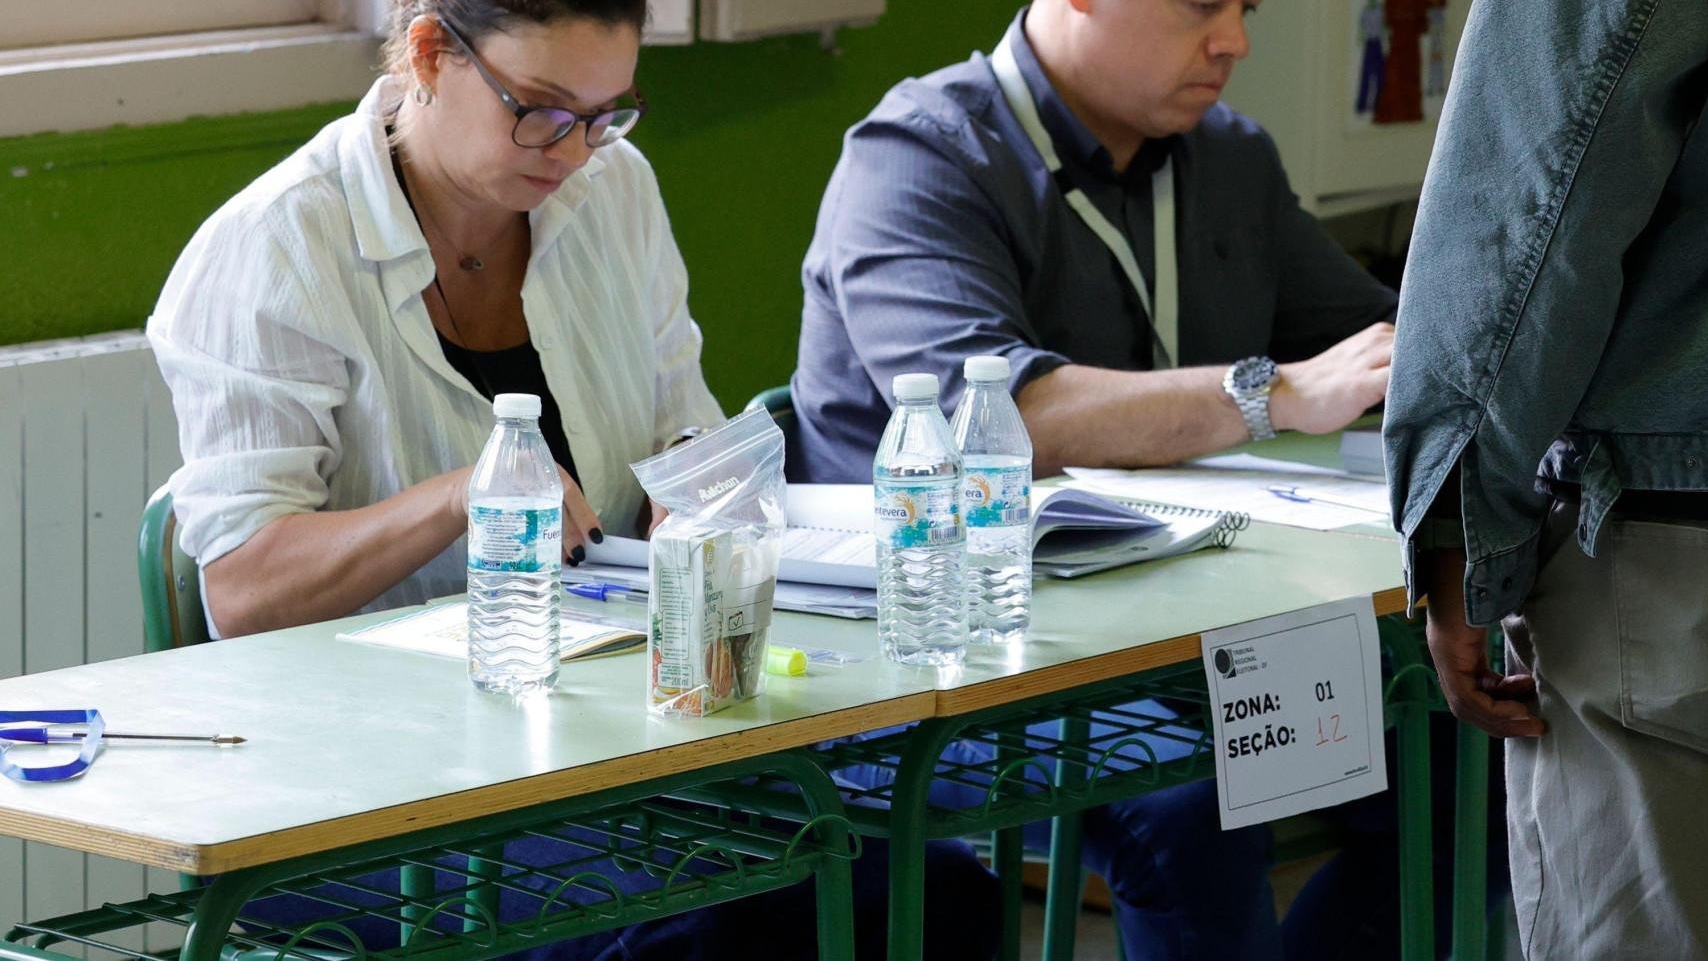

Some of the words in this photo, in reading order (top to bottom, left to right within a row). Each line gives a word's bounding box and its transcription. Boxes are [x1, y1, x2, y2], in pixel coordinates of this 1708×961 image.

[1223, 693, 1281, 723] ZONA:
[1315, 680, 1335, 702] 01
[1227, 725, 1297, 759] SEÇÃO:
